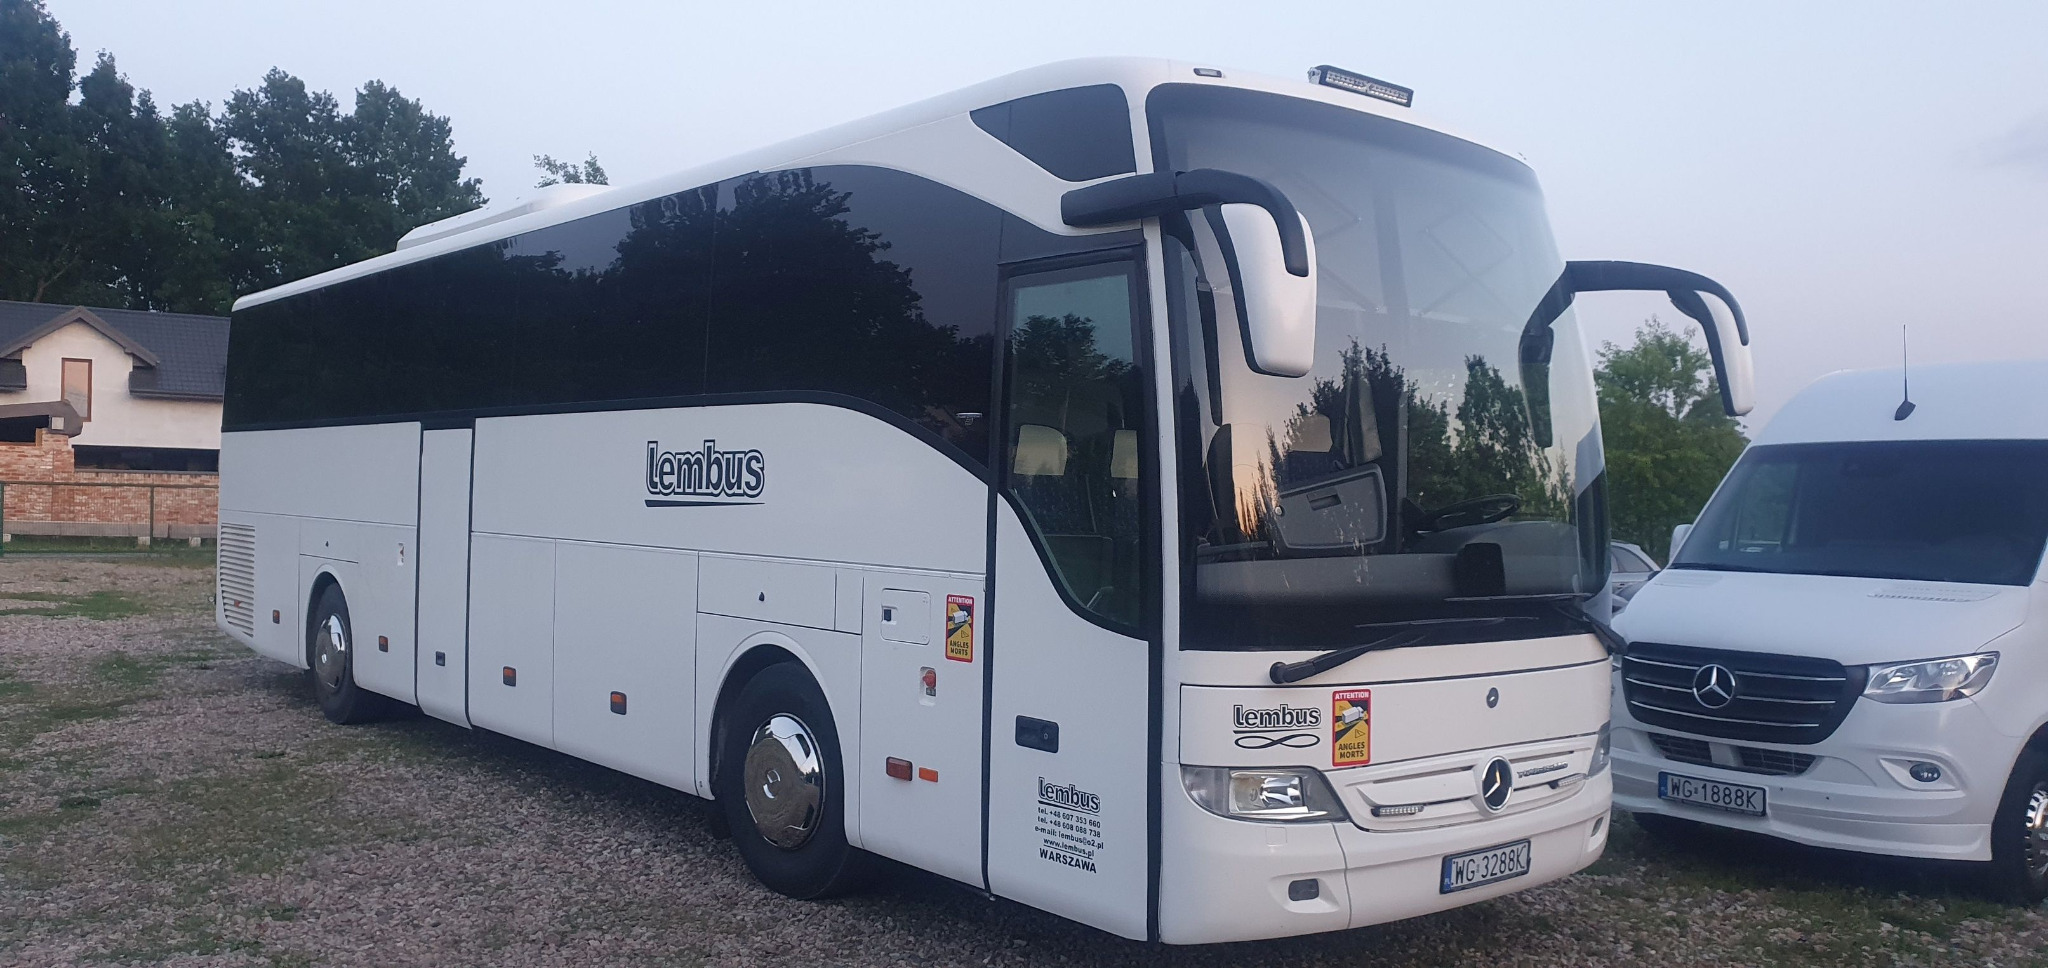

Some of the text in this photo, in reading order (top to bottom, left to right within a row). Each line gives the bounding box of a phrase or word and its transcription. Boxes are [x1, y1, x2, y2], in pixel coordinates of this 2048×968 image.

[646, 439, 765, 498] lembus
[948, 596, 973, 605] ATTENTION
[950, 640, 969, 649] ANGLES
[950, 647, 968, 656] MORTS
[1334, 691, 1369, 700] ATTENTION
[1233, 704, 1322, 728] lembus
[1338, 741, 1365, 751] ANGLES
[1339, 750, 1364, 759] MORTS
[1038, 776, 1101, 813] lembus
[1670, 777, 1757, 810] WG 1888K
[1037, 807, 1101, 829] tel. +48 607 353 660
[1037, 816, 1048, 824] tel.
[1050, 820, 1061, 828] +48
[1088, 829, 1101, 838] 738
[1034, 826, 1057, 837] e-mail:
[1043, 838, 1095, 858] www.lembus.pl
[1039, 847, 1097, 874] WARSZAWA
[1455, 844, 1527, 885] WG 3288K
